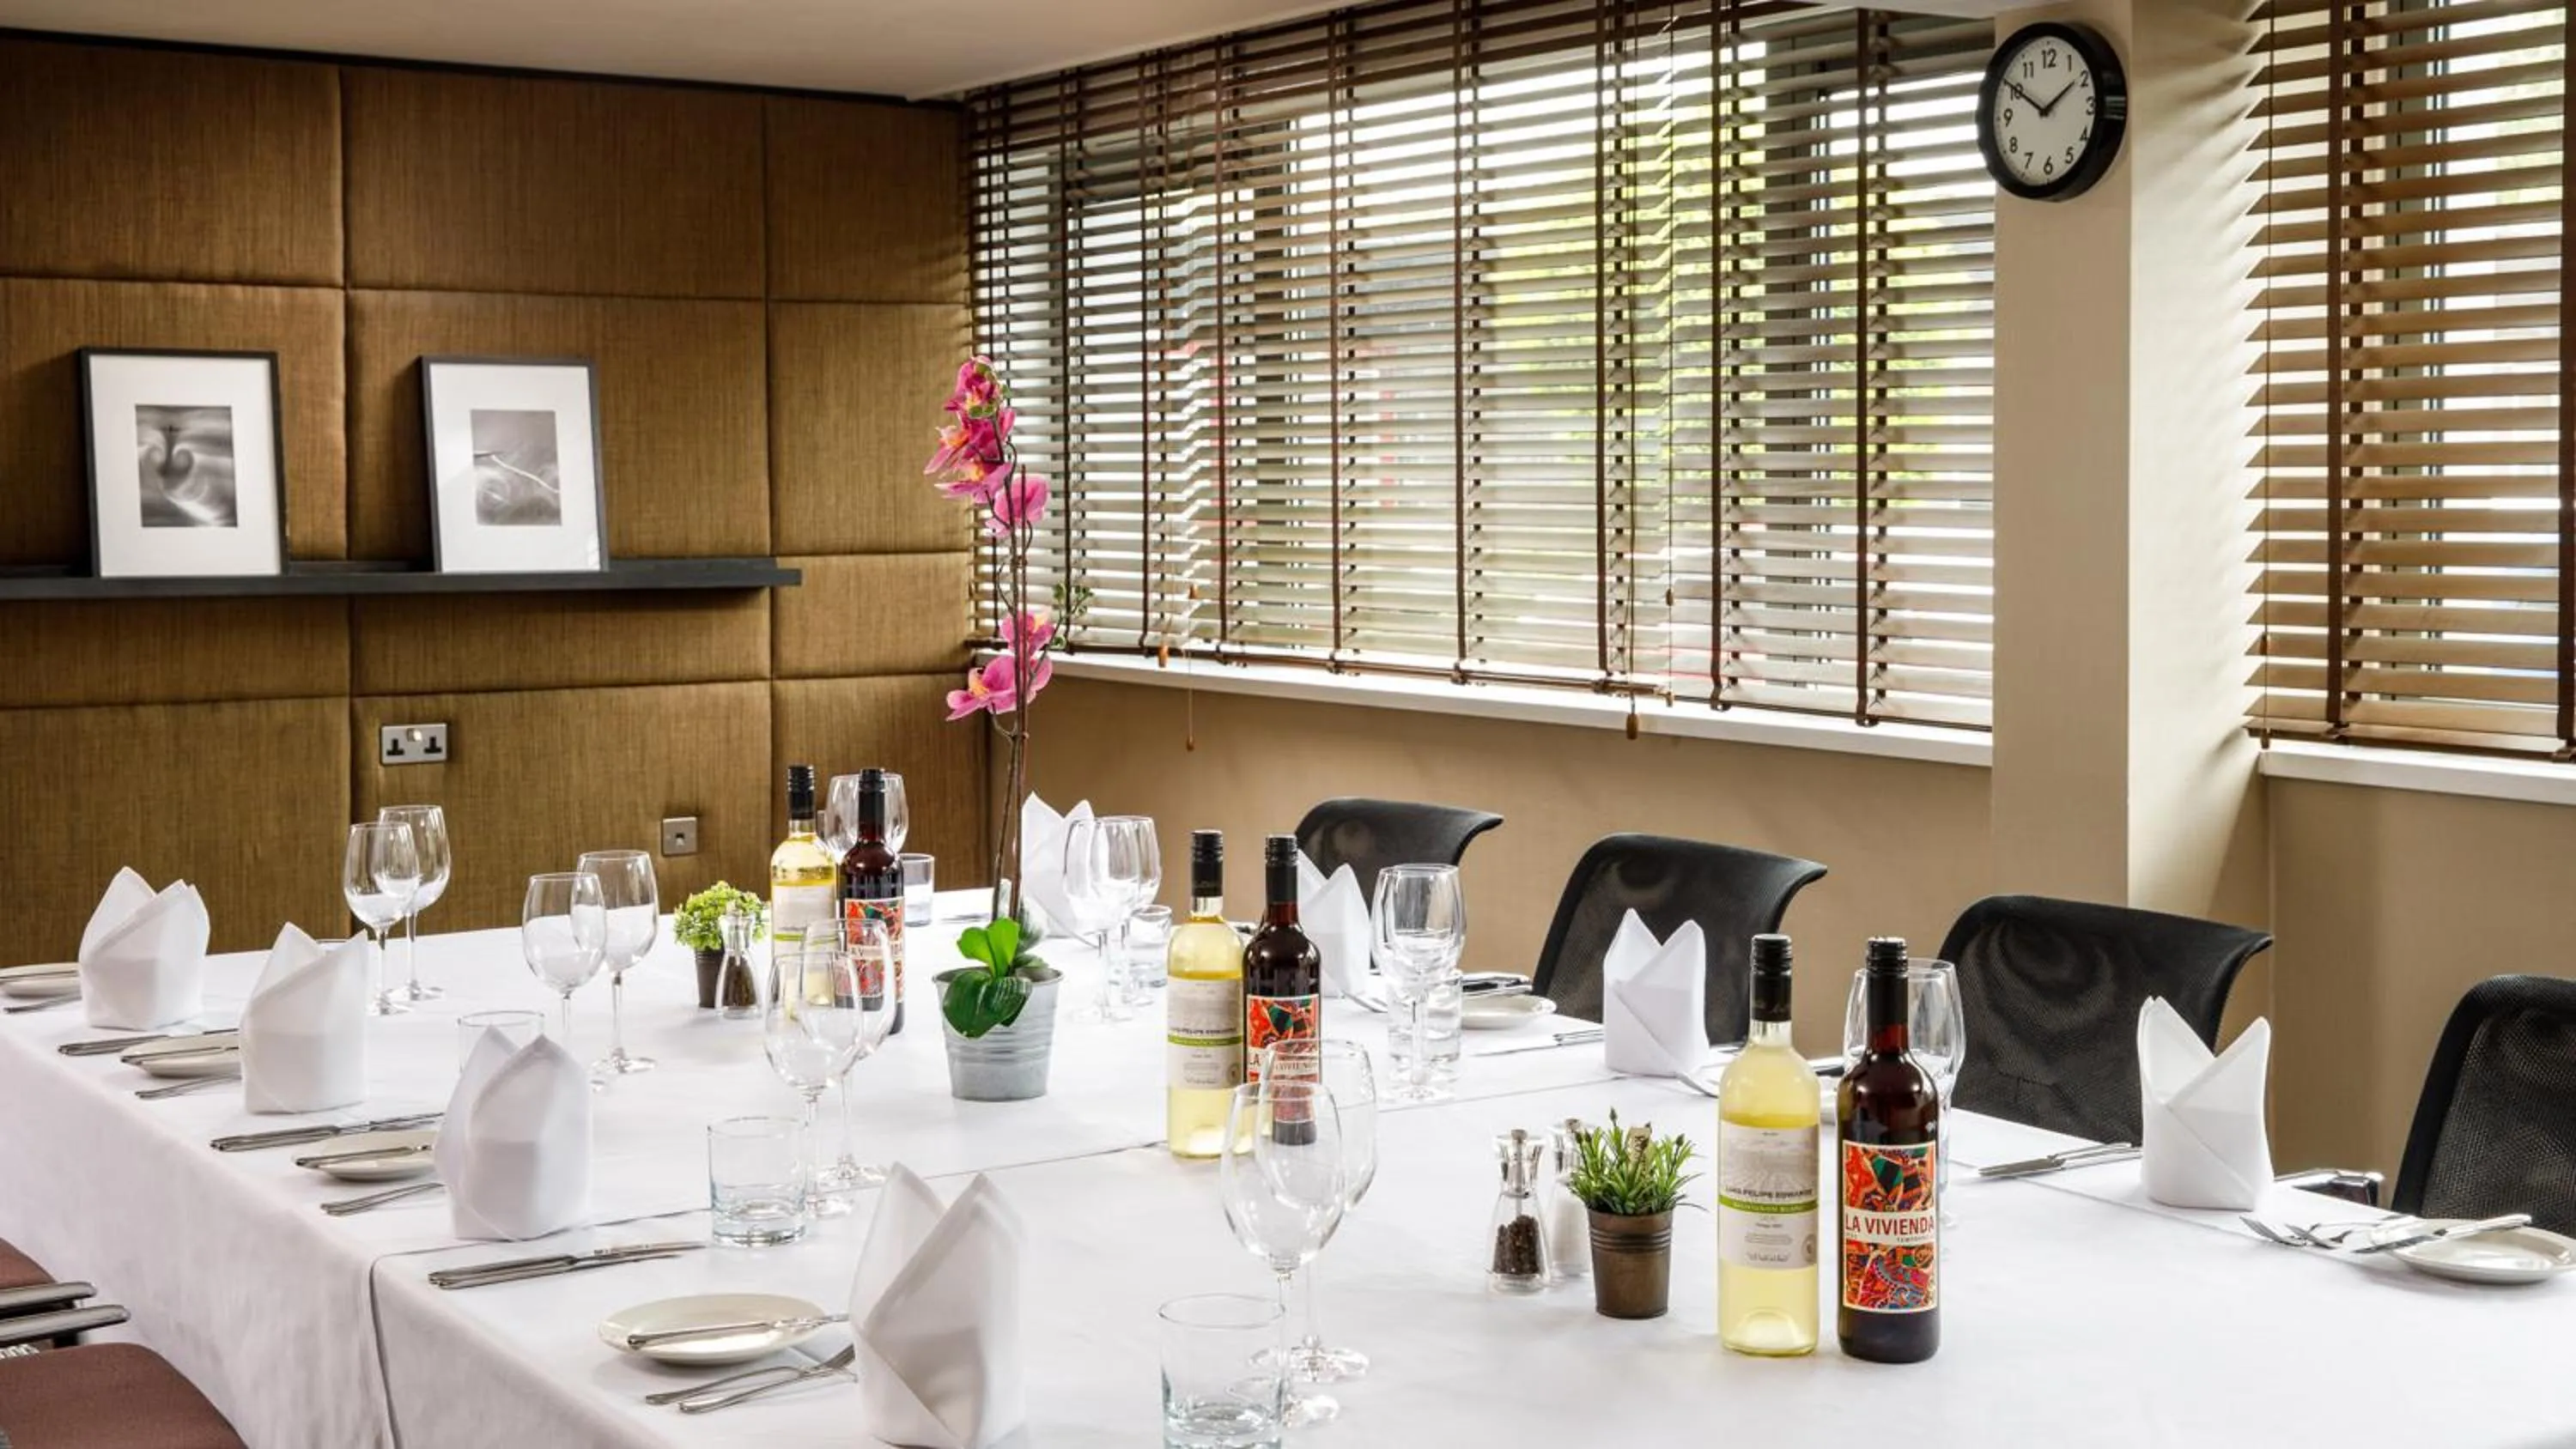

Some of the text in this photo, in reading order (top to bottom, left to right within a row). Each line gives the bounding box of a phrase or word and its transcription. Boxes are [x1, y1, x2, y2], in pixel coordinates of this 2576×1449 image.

[2041, 48, 2057, 69] 12
[2067, 54, 2073, 72] 1
[2022, 61, 2034, 80] 11
[2080, 70, 2089, 88] 2
[2009, 82, 2024, 100] 10
[2086, 96, 2096, 116] 3
[2003, 108, 2014, 127] 9
[2079, 127, 2088, 142] 4
[2008, 136, 2019, 154] 8
[2024, 152, 2034, 169] 7
[2064, 147, 2075, 165] 5
[2043, 156, 2054, 175] 6
[1845, 1214, 1935, 1235] LA VIVIENDA
